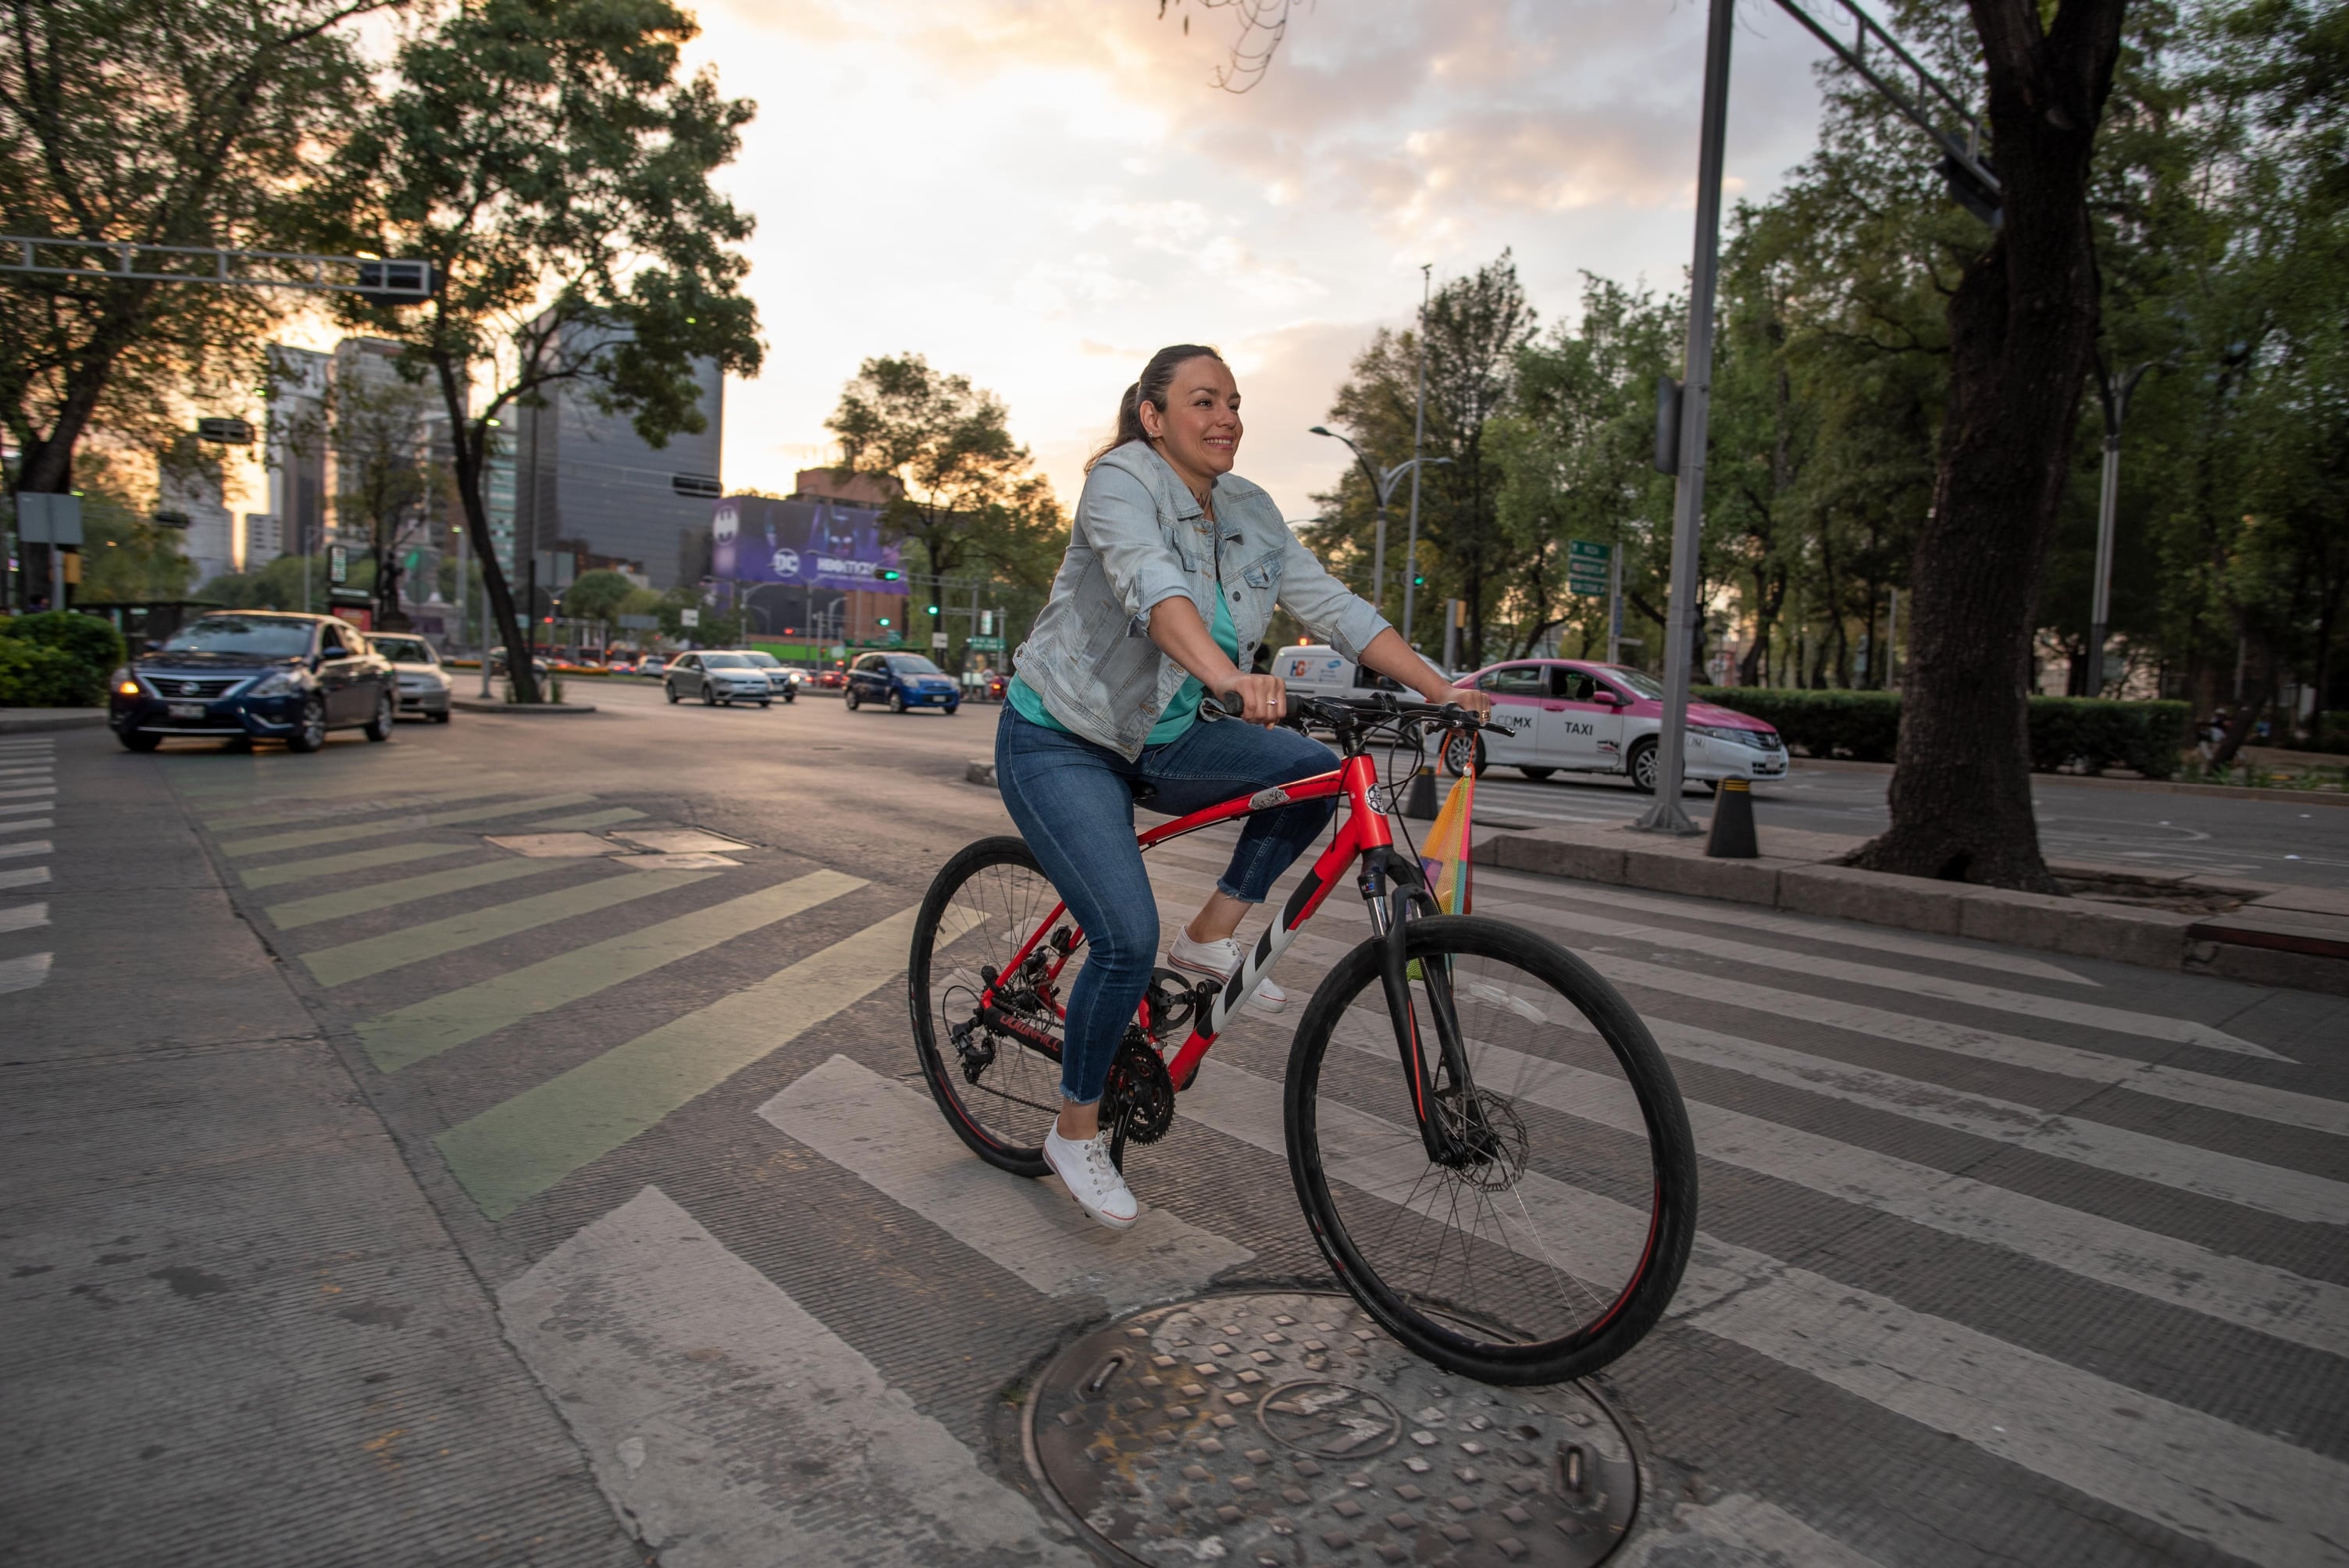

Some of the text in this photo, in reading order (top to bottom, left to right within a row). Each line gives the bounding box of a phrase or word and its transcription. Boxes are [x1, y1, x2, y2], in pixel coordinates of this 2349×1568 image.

[773, 550, 799, 575] DC
[1495, 715, 1531, 728] CDMX
[1565, 722, 1593, 736] TAXI
